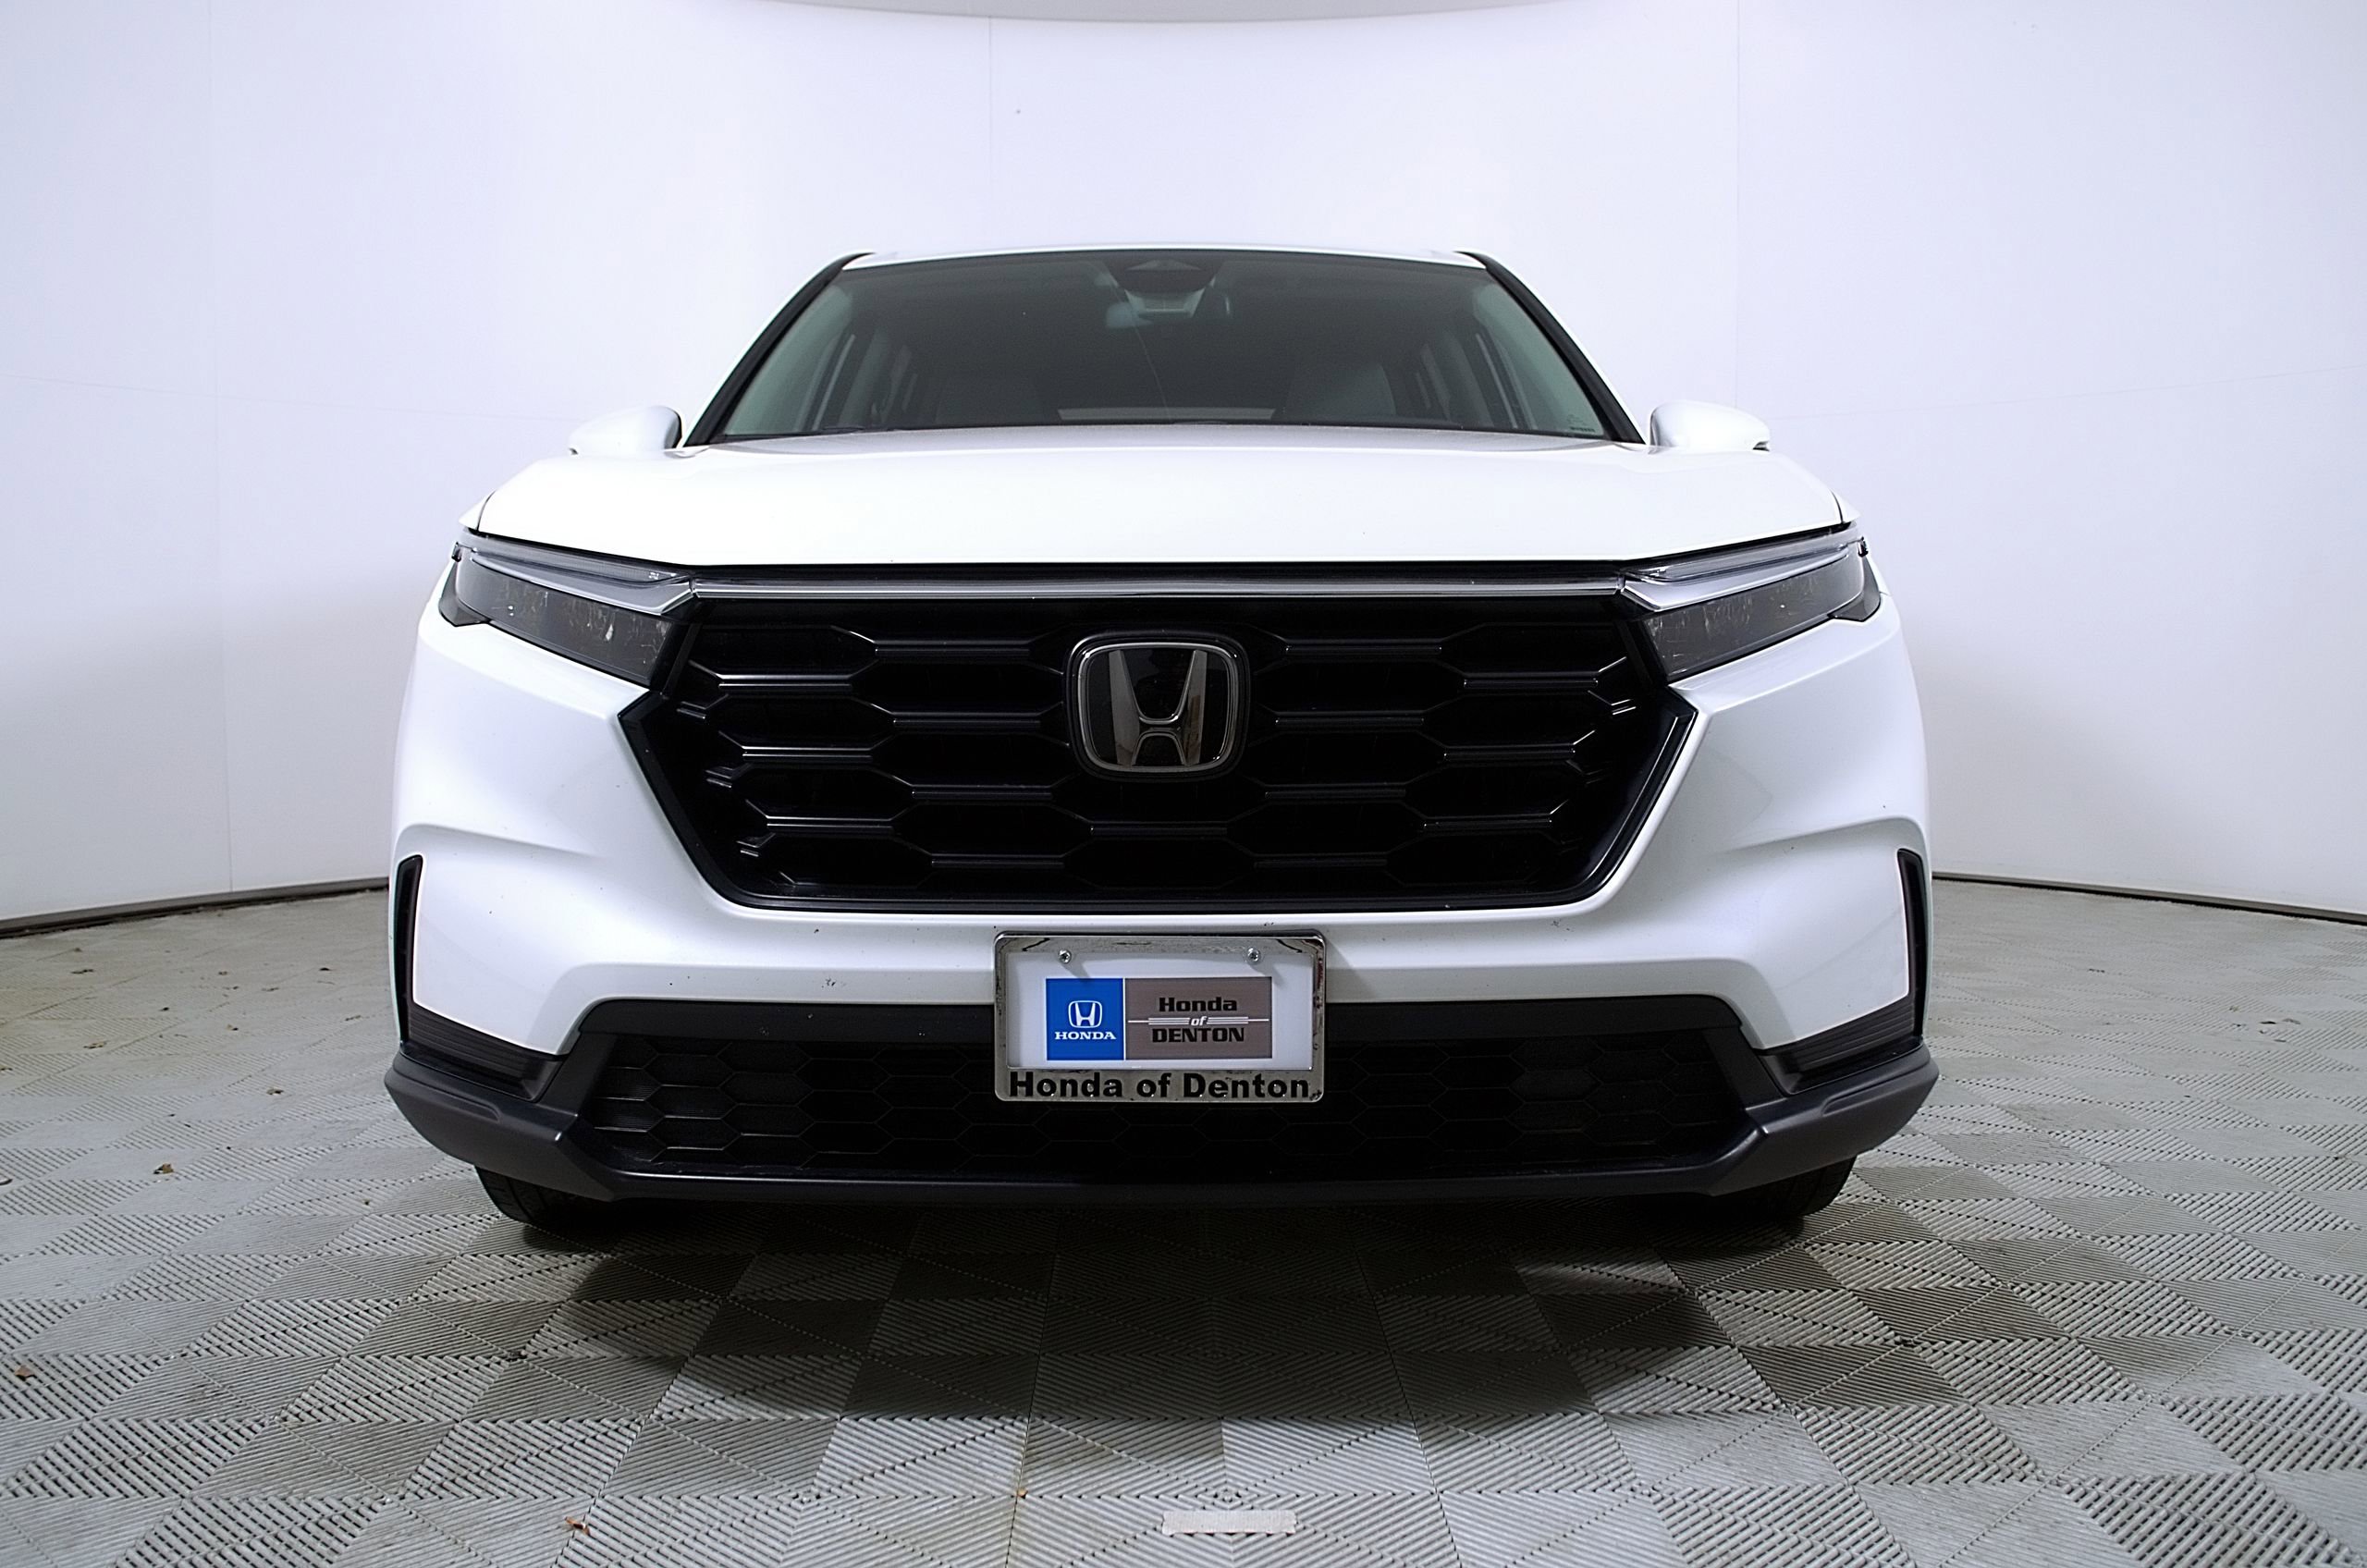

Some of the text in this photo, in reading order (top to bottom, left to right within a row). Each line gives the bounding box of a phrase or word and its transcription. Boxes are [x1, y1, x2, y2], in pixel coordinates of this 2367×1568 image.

[1159, 997, 1237, 1011] Honda
[1190, 1016, 1208, 1026] of
[1054, 1031, 1117, 1040] HONDA
[1152, 1027, 1245, 1043] DENTON
[1010, 1072, 1309, 1098] Honda of Denton
